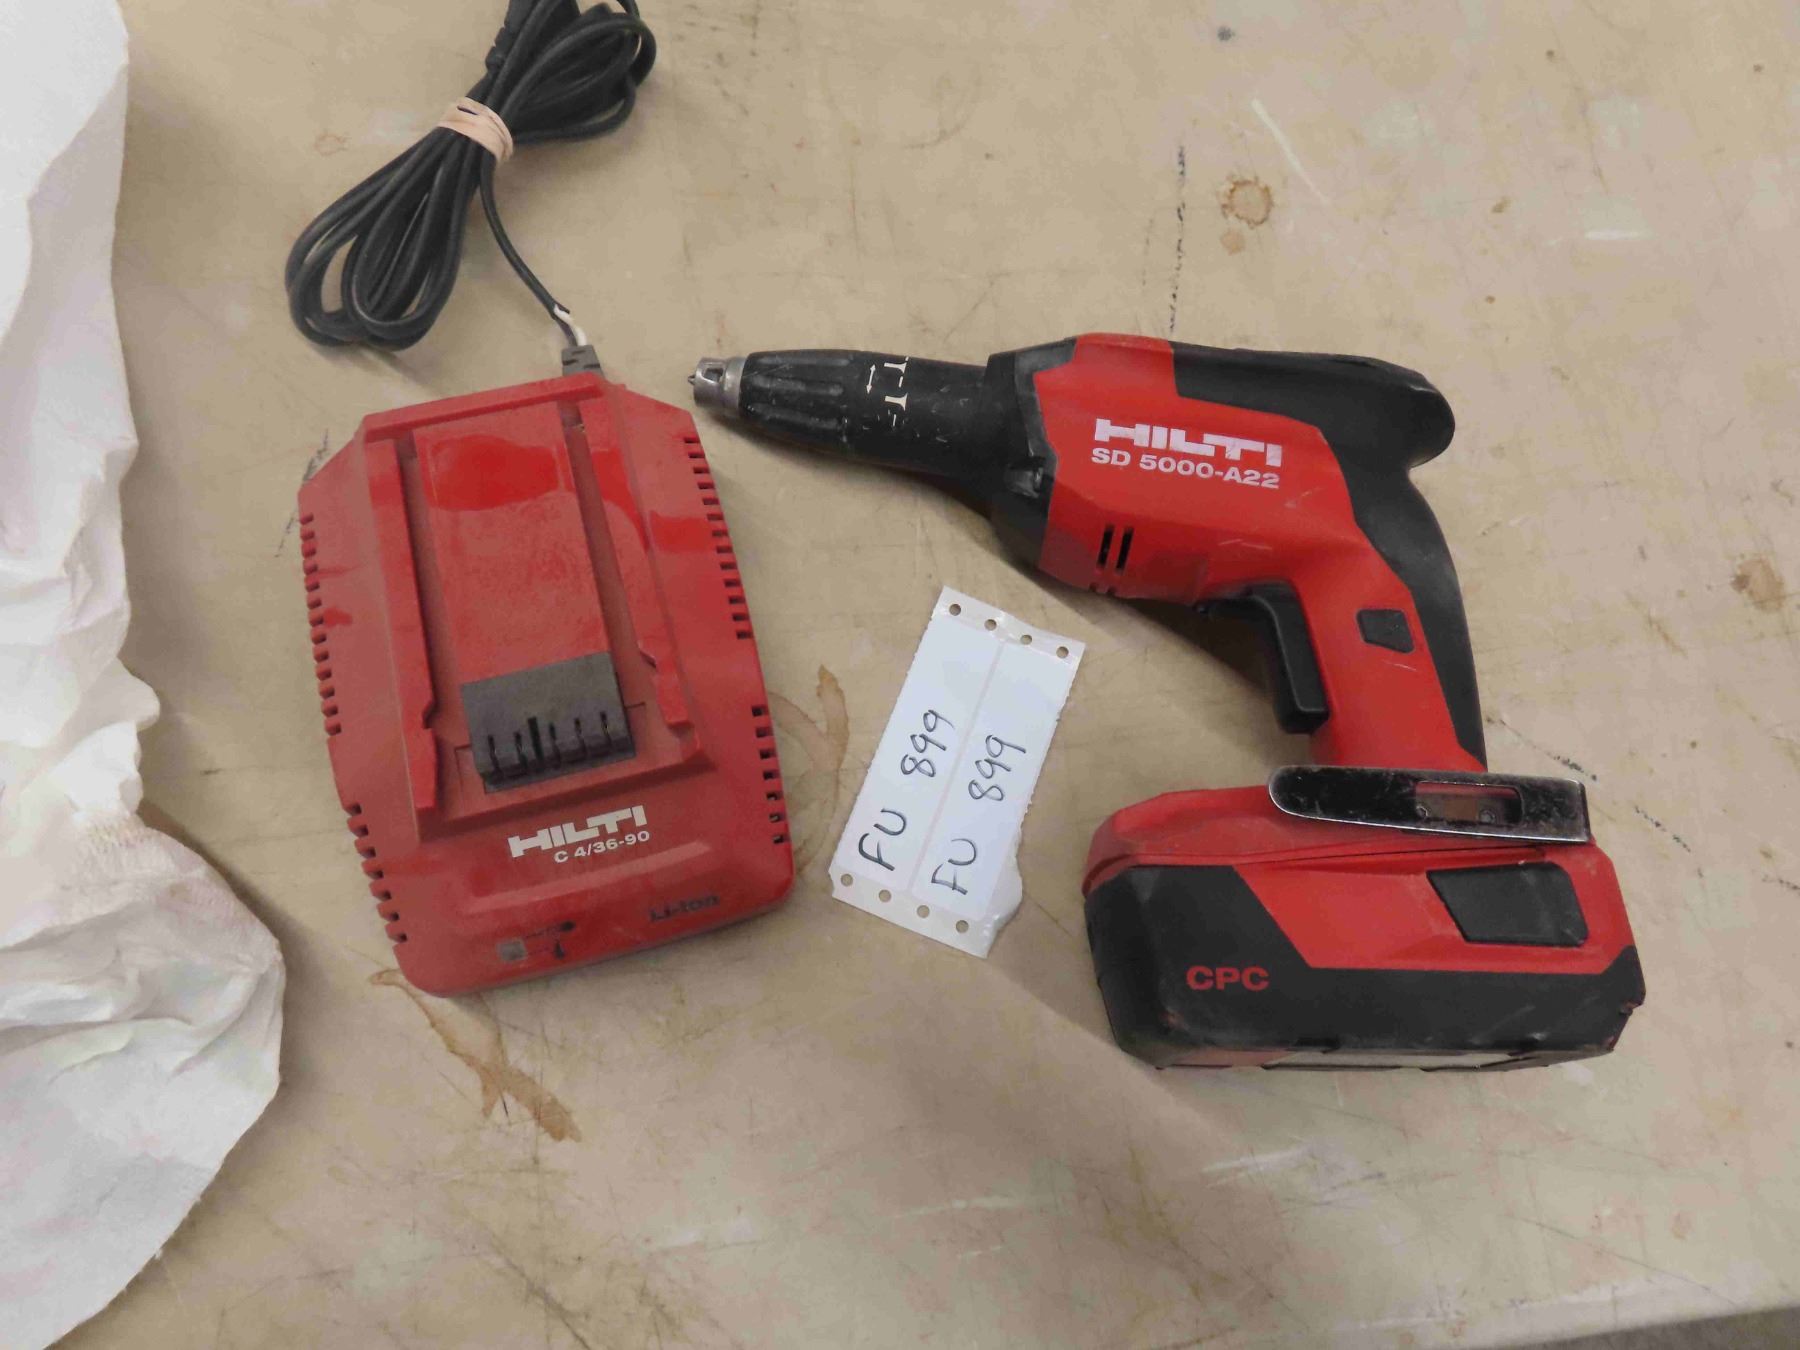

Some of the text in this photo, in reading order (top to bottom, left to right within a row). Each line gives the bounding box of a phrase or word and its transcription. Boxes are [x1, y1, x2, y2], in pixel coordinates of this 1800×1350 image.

[1095, 418, 1282, 467] HILTI
[1091, 447, 1280, 489] SD 5000-A22
[858, 709, 955, 871] FU 899
[931, 734, 1026, 895] FU 899
[507, 805, 647, 858] HILTI
[554, 830, 650, 863] C 4/36-90
[1186, 965, 1270, 991] CPC
